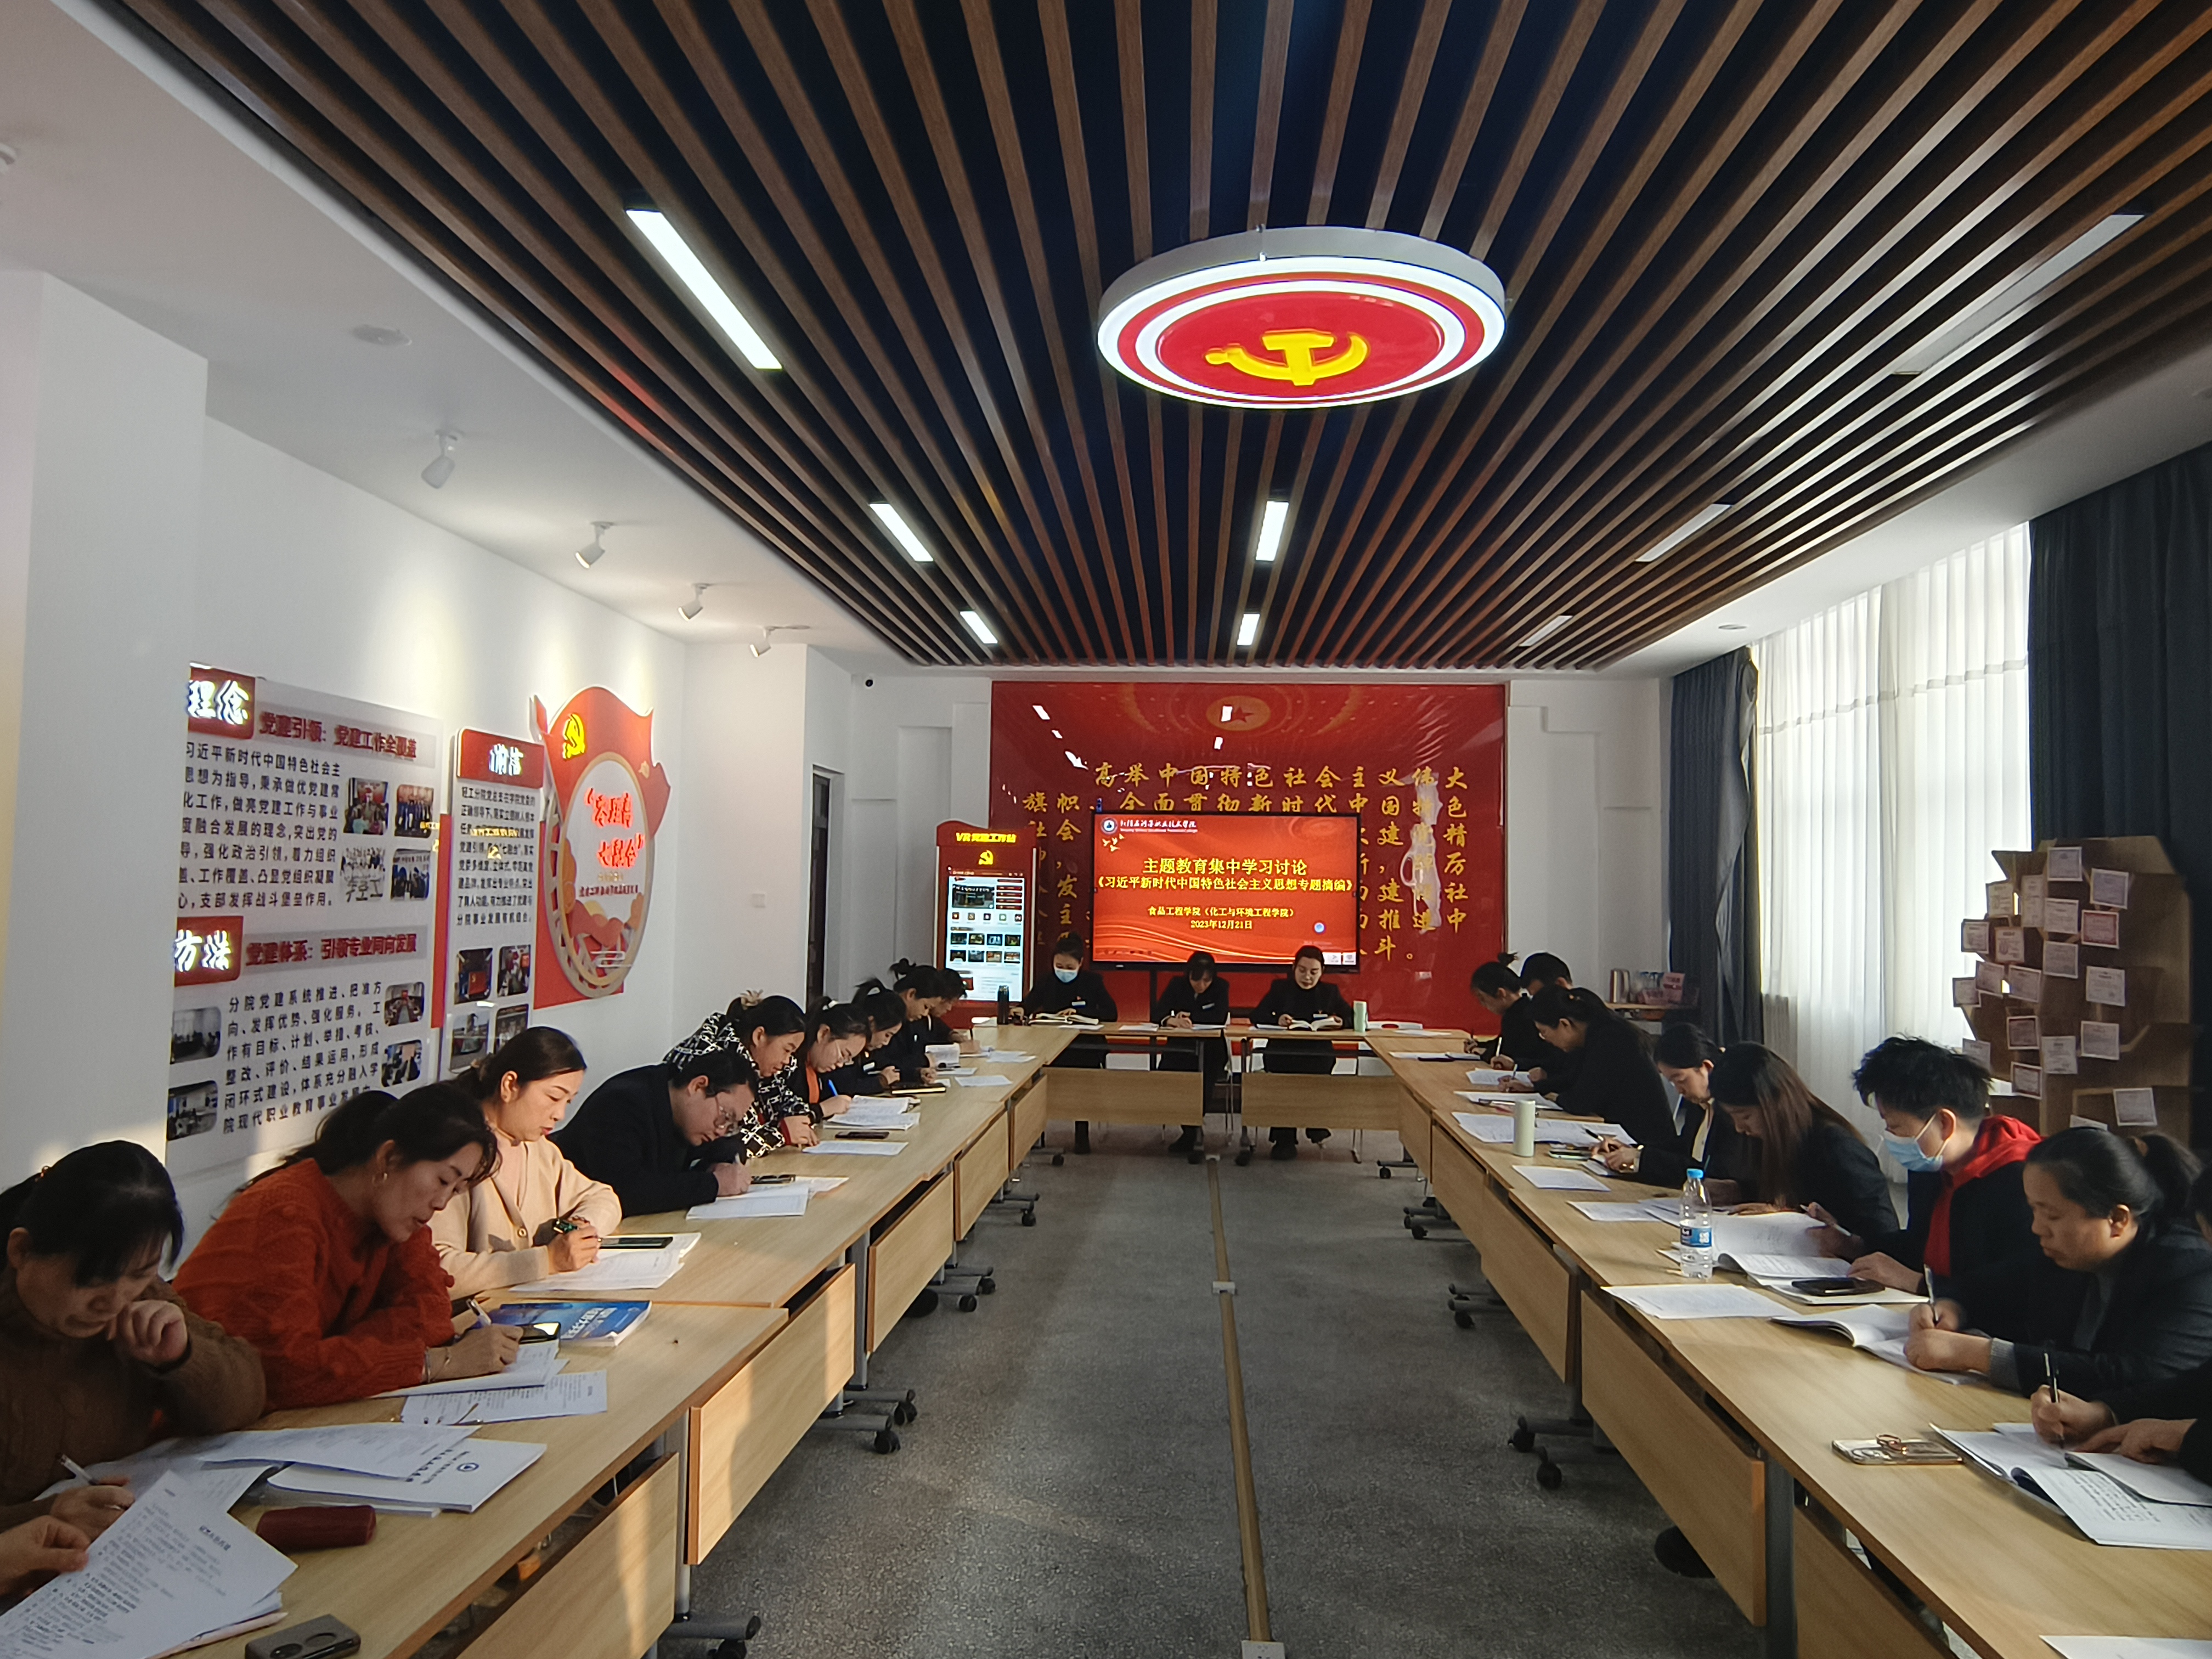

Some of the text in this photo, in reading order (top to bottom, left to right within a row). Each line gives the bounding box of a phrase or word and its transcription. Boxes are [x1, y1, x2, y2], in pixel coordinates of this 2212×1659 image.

[188, 680, 249, 725] 理念
[186, 742, 340, 777] 习近平新时代中国特色社会主
[1096, 762, 1468, 789] 高举中国特色社会主义伟大
[1143, 857, 1307, 875] 主题教育集中学习讨论
[1098, 877, 1353, 891] 《习近平新时代中国特色社会主义思想专题摘编》
[1148, 906, 1294, 918] 食品工程学院（化工与环境工程学院）
[1190, 919, 1252, 930] 2023年12月21日
[174, 929, 231, 972] 方法
